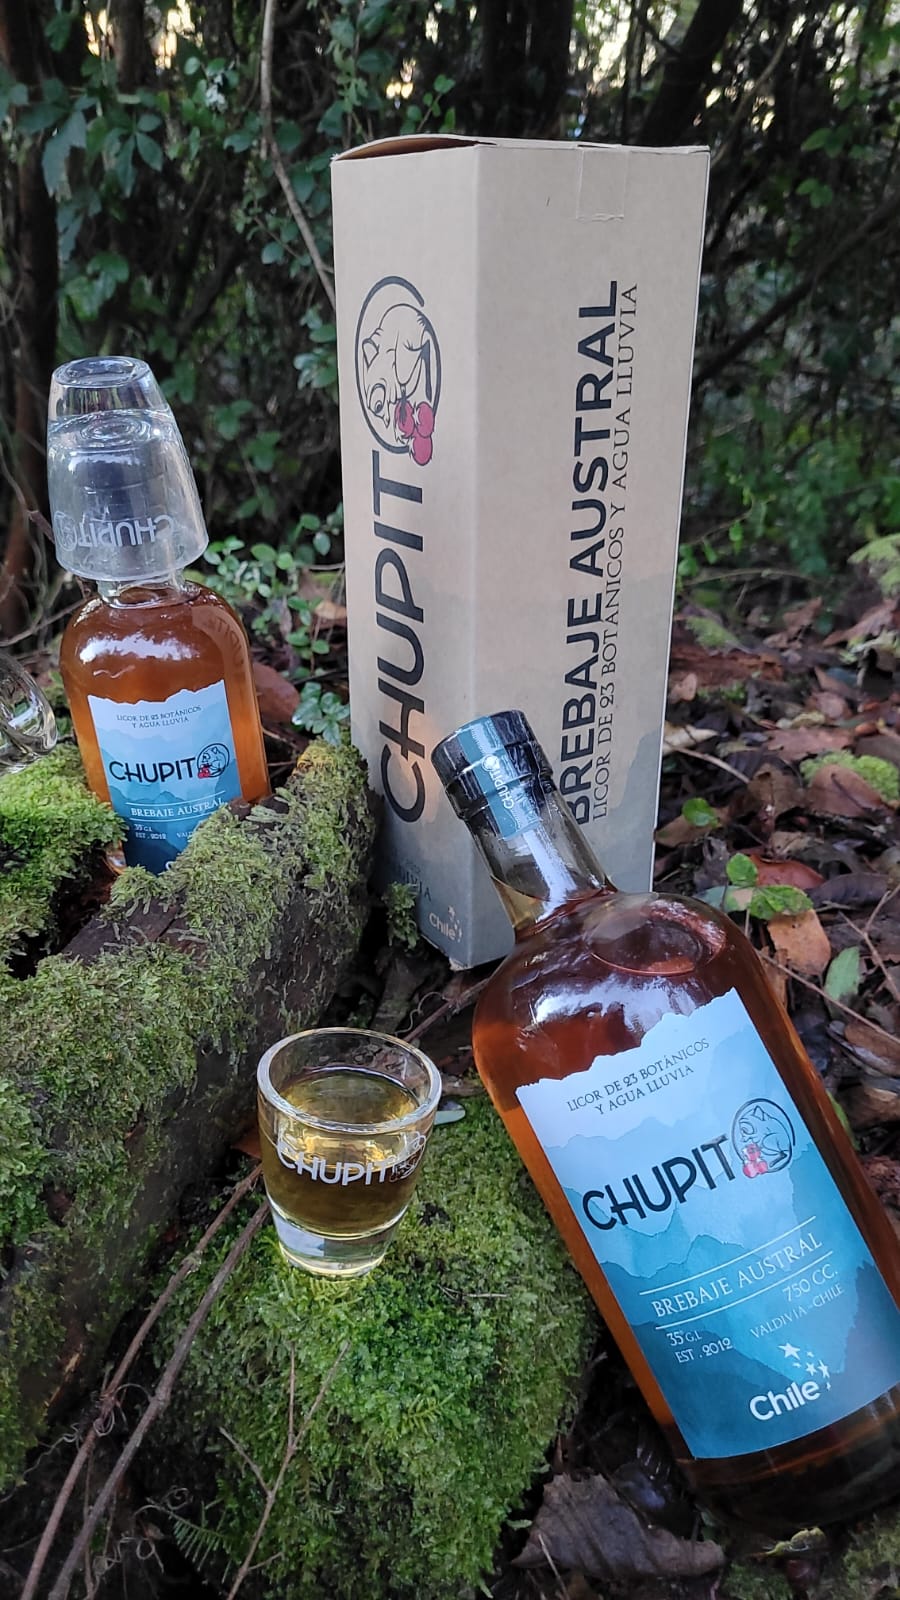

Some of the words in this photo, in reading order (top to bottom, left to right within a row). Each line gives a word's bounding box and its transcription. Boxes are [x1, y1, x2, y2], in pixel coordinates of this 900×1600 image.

[616, 283, 638, 398] LLUVIA
[568, 280, 618, 577] AUSTRAL
[611, 407, 632, 491] AGUA
[610, 502, 626, 520] Y
[599, 682, 615, 709] 23
[116, 714, 138, 722] LICOR
[139, 719, 161, 728] AGUA
[597, 713, 613, 745] DE
[592, 751, 611, 821] LICOR
[177, 797, 226, 815] AUSTRAL
[429, 912, 456, 941] Chile
[566, 1090, 603, 1112] LICOR
[604, 1080, 623, 1096] DE
[623, 1073, 639, 1087] 23
[639, 1037, 710, 1080] BOTÁNICOS
[594, 1103, 605, 1115] Y
[608, 1087, 646, 1112] AGUA
[646, 1064, 695, 1093] LLUVIA
[651, 1276, 734, 1318] BREBAJE
[737, 1232, 823, 1289] AUSTRAL
[782, 1278, 811, 1302] 750
[749, 1380, 821, 1421] Chile
